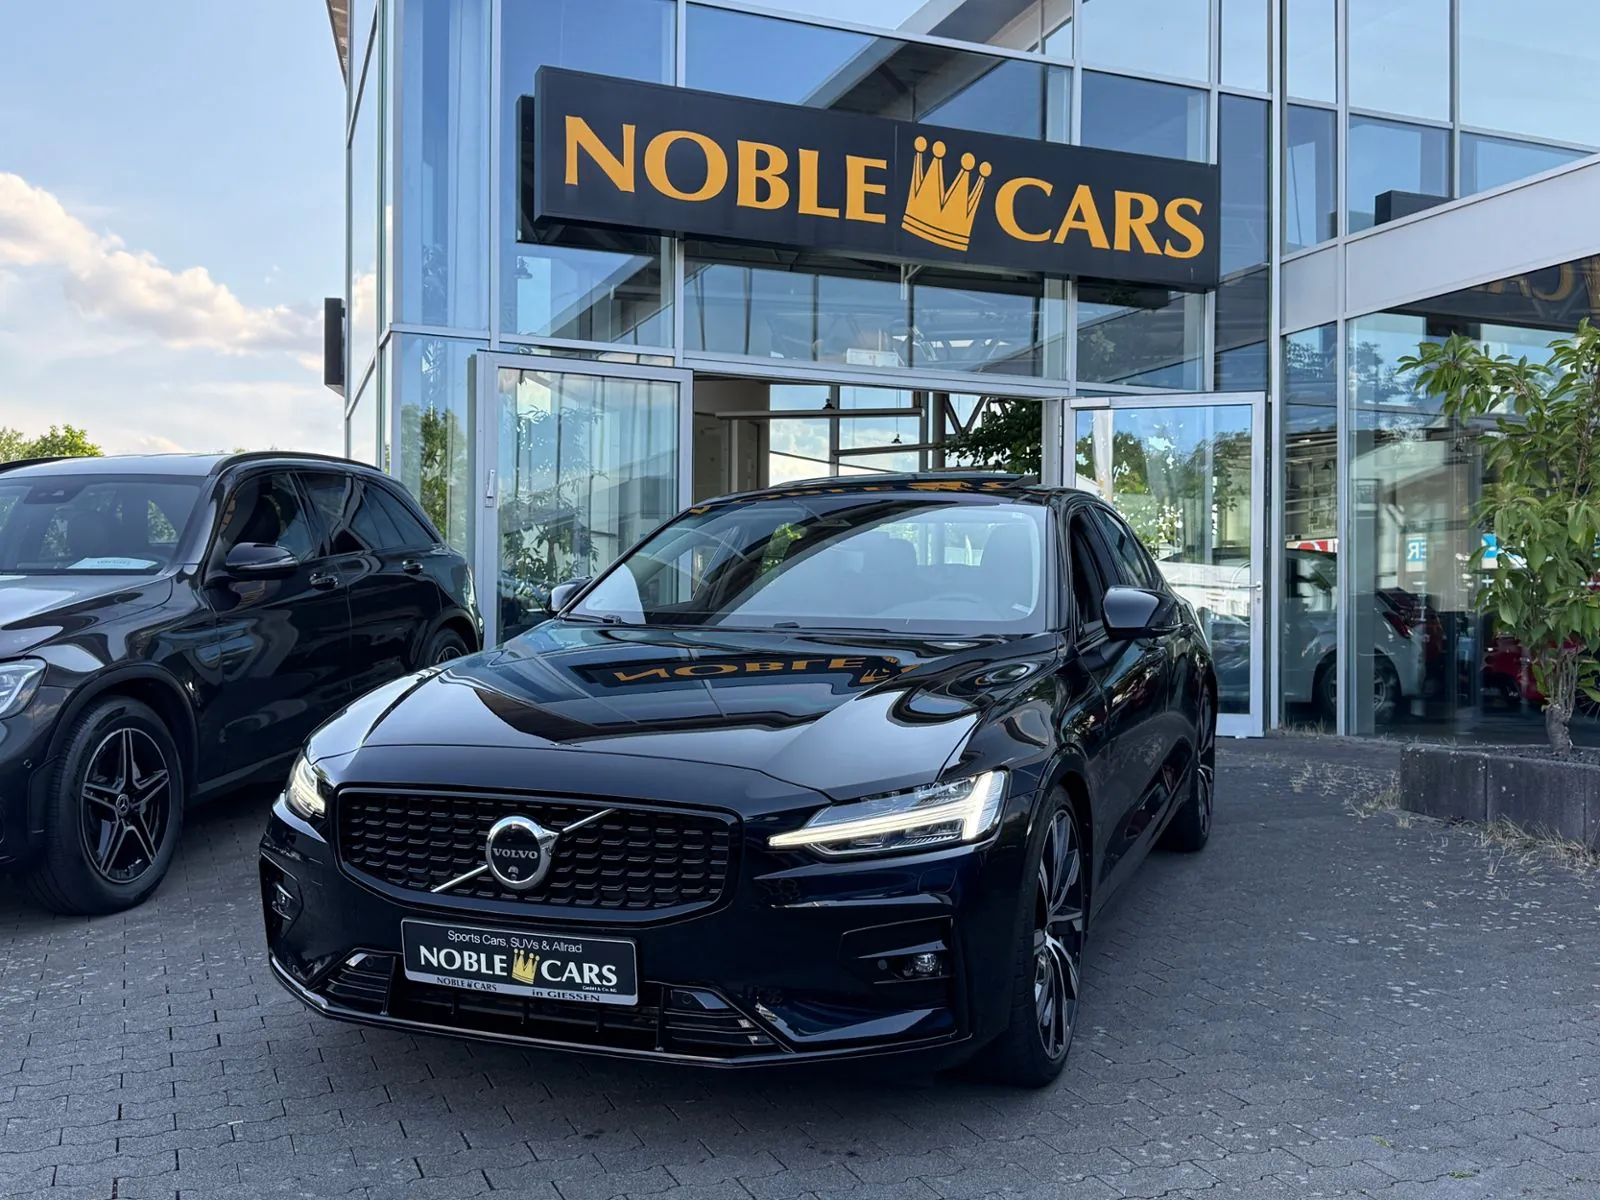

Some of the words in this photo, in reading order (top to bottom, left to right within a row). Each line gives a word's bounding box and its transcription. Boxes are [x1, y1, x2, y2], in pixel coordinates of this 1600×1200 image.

[564, 114, 888, 224] NOBLE
[994, 177, 1204, 259] CARS
[492, 847, 538, 860] VOLVO
[447, 929, 481, 944] Sports
[482, 934, 509, 948] Cars,
[510, 937, 540, 950] SUVs
[541, 940, 550, 951] &
[552, 941, 583, 953] Allrad
[419, 944, 508, 977] NOBLE
[540, 959, 618, 987] CARS
[436, 976, 467, 988] NOBLE
[473, 982, 498, 992] CARS
[532, 988, 544, 997] in
[547, 990, 601, 1002] GIESSEN
